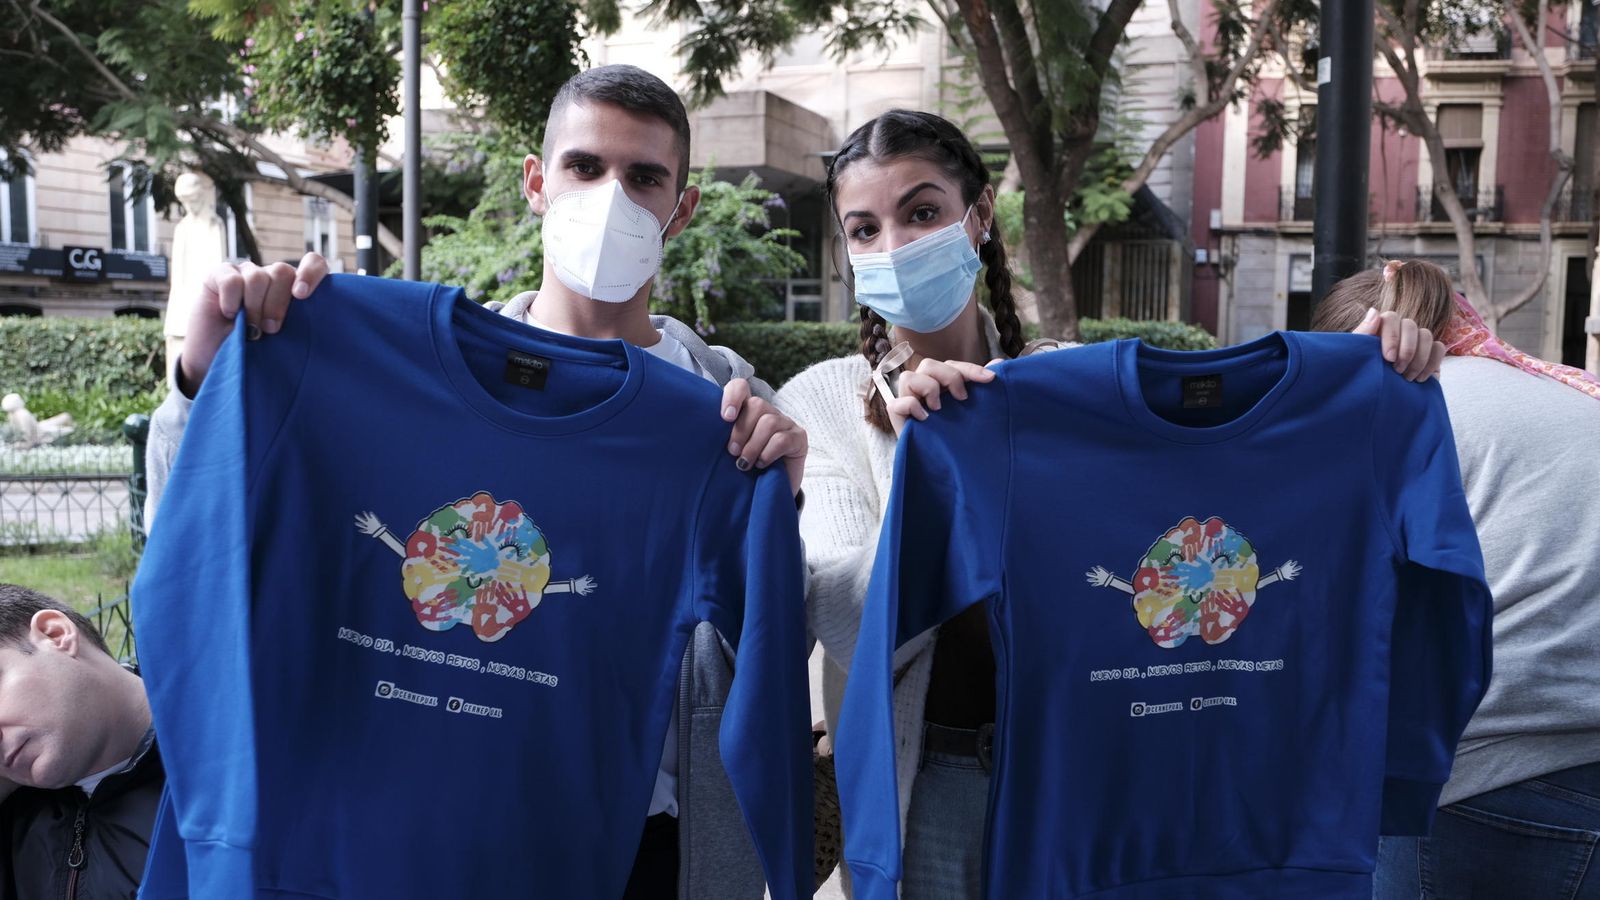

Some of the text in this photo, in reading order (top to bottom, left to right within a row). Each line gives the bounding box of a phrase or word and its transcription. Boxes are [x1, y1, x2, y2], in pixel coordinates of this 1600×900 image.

[338, 627, 373, 648] NUEVO
[402, 644, 445, 664] NUEVOS
[446, 654, 480, 671] RETOS
[486, 661, 525, 680] NUEVAS
[526, 670, 559, 687] METAS
[1090, 669, 1121, 682] NUEVO
[1147, 664, 1183, 678] NUEVOS
[1184, 660, 1211, 673] RETOS
[1217, 659, 1254, 672] NUEVAS
[1255, 659, 1284, 672] METAS
